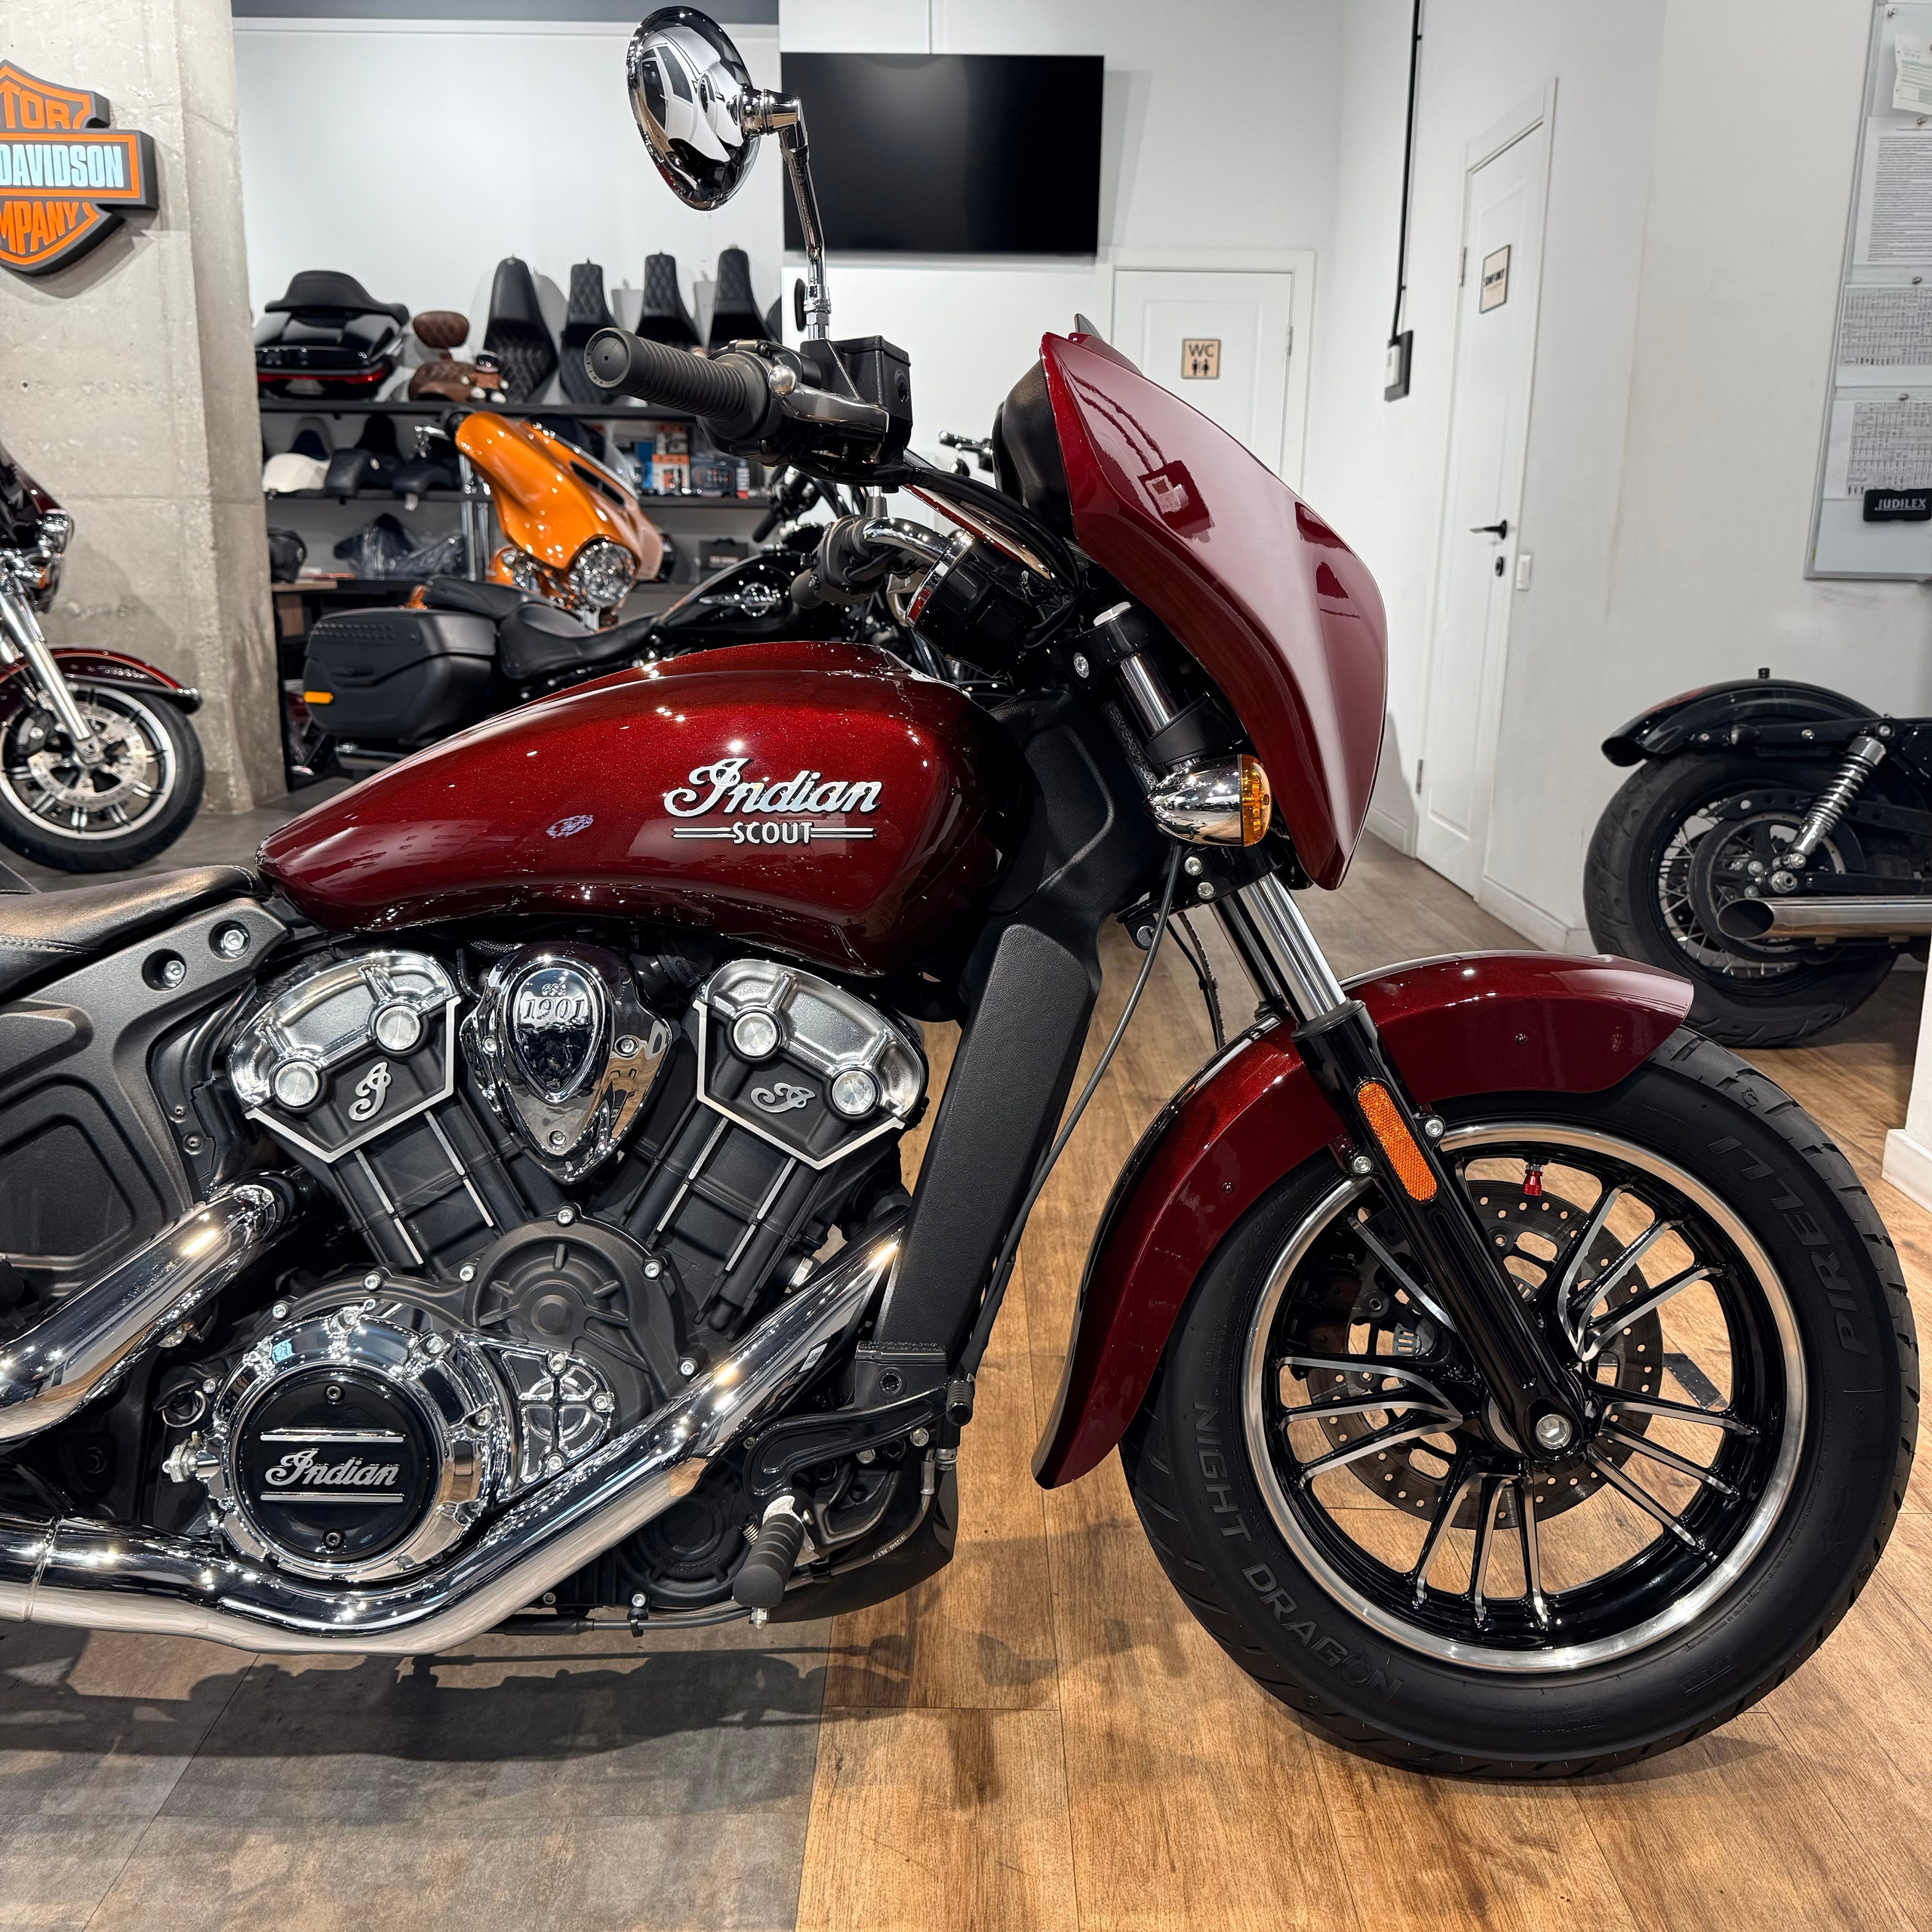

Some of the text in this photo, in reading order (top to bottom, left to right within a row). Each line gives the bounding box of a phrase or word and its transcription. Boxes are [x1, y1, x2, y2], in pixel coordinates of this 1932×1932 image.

[1188, 343, 1214, 358] WC
[1874, 498, 1927, 512] JUDILEX
[663, 757, 883, 817] Indian
[733, 821, 814, 844] SCOUT
[523, 998, 586, 1020] 1901
[1706, 1135, 1869, 1356] PIRELLI
[264, 1447, 400, 1486] Indian
[1192, 1400, 1404, 1702] NIGHT DRAGON
